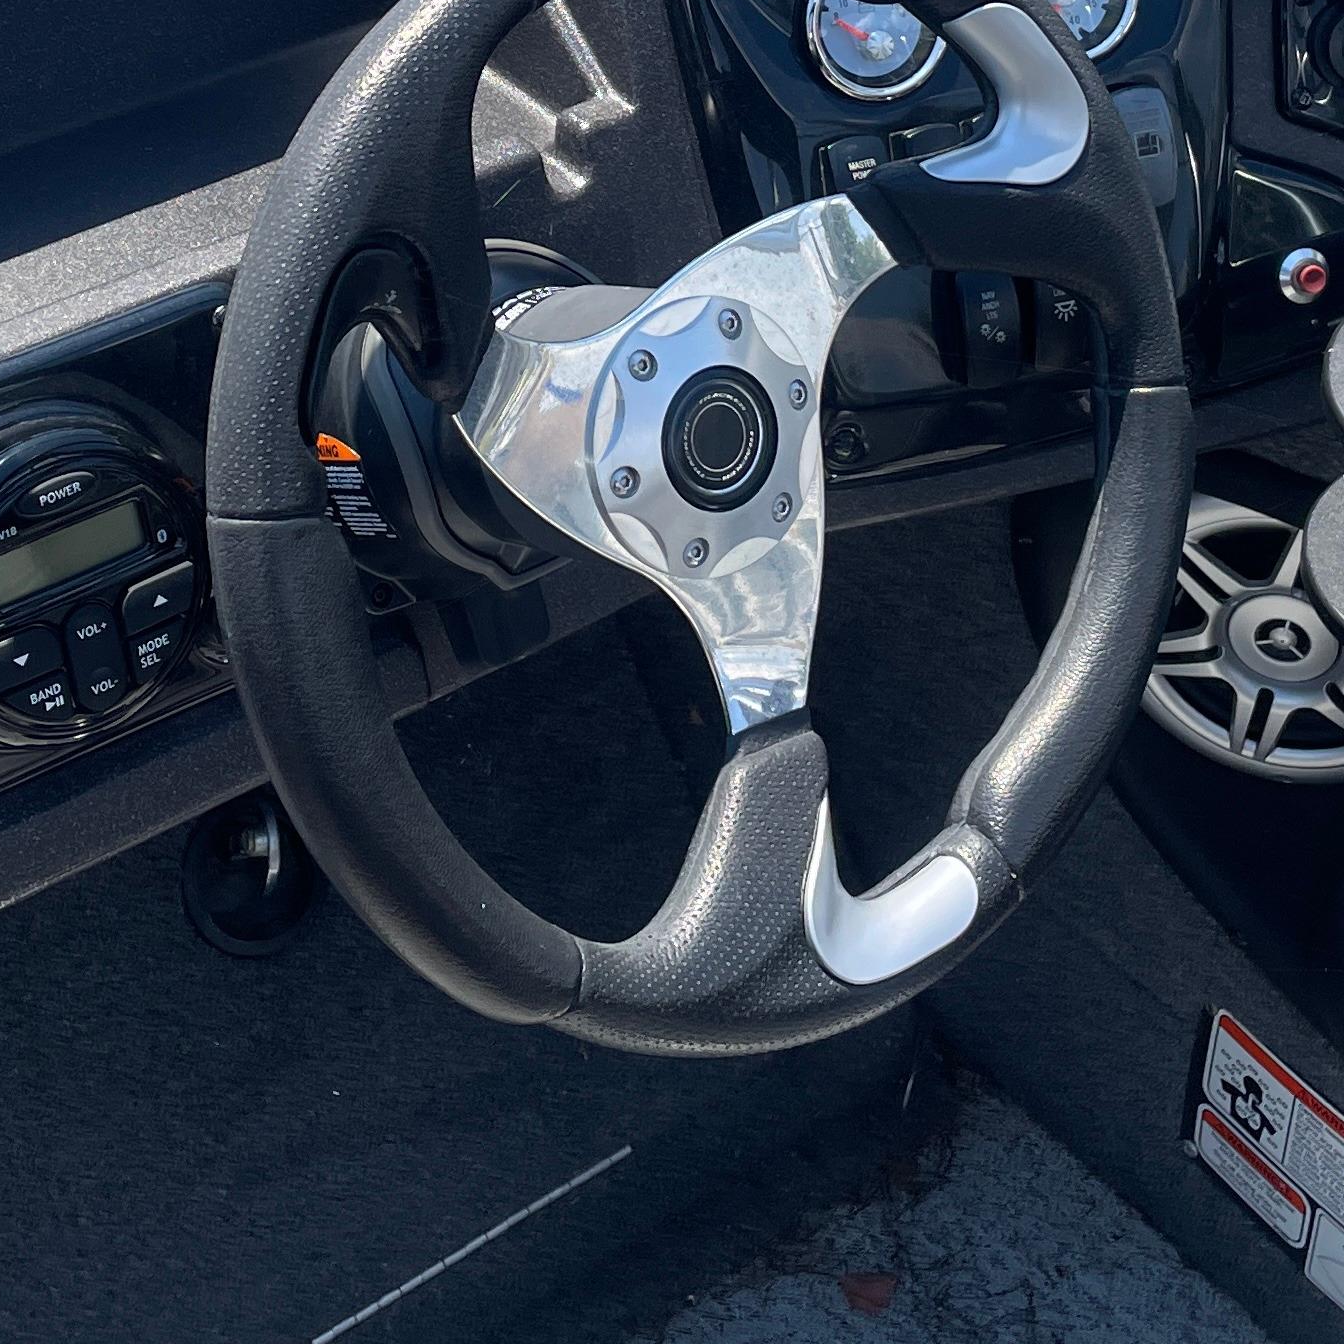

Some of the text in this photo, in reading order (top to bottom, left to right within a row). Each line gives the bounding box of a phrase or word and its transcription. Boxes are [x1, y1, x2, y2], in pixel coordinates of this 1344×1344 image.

[848, 158, 877, 171] MASTER
[38, 481, 82, 507] POWER
[76, 621, 108, 640] VOL+
[137, 633, 170, 656] MODE
[140, 654, 161, 669] SEL
[29, 683, 62, 705] BAND
[90, 678, 119, 695] VOL-
